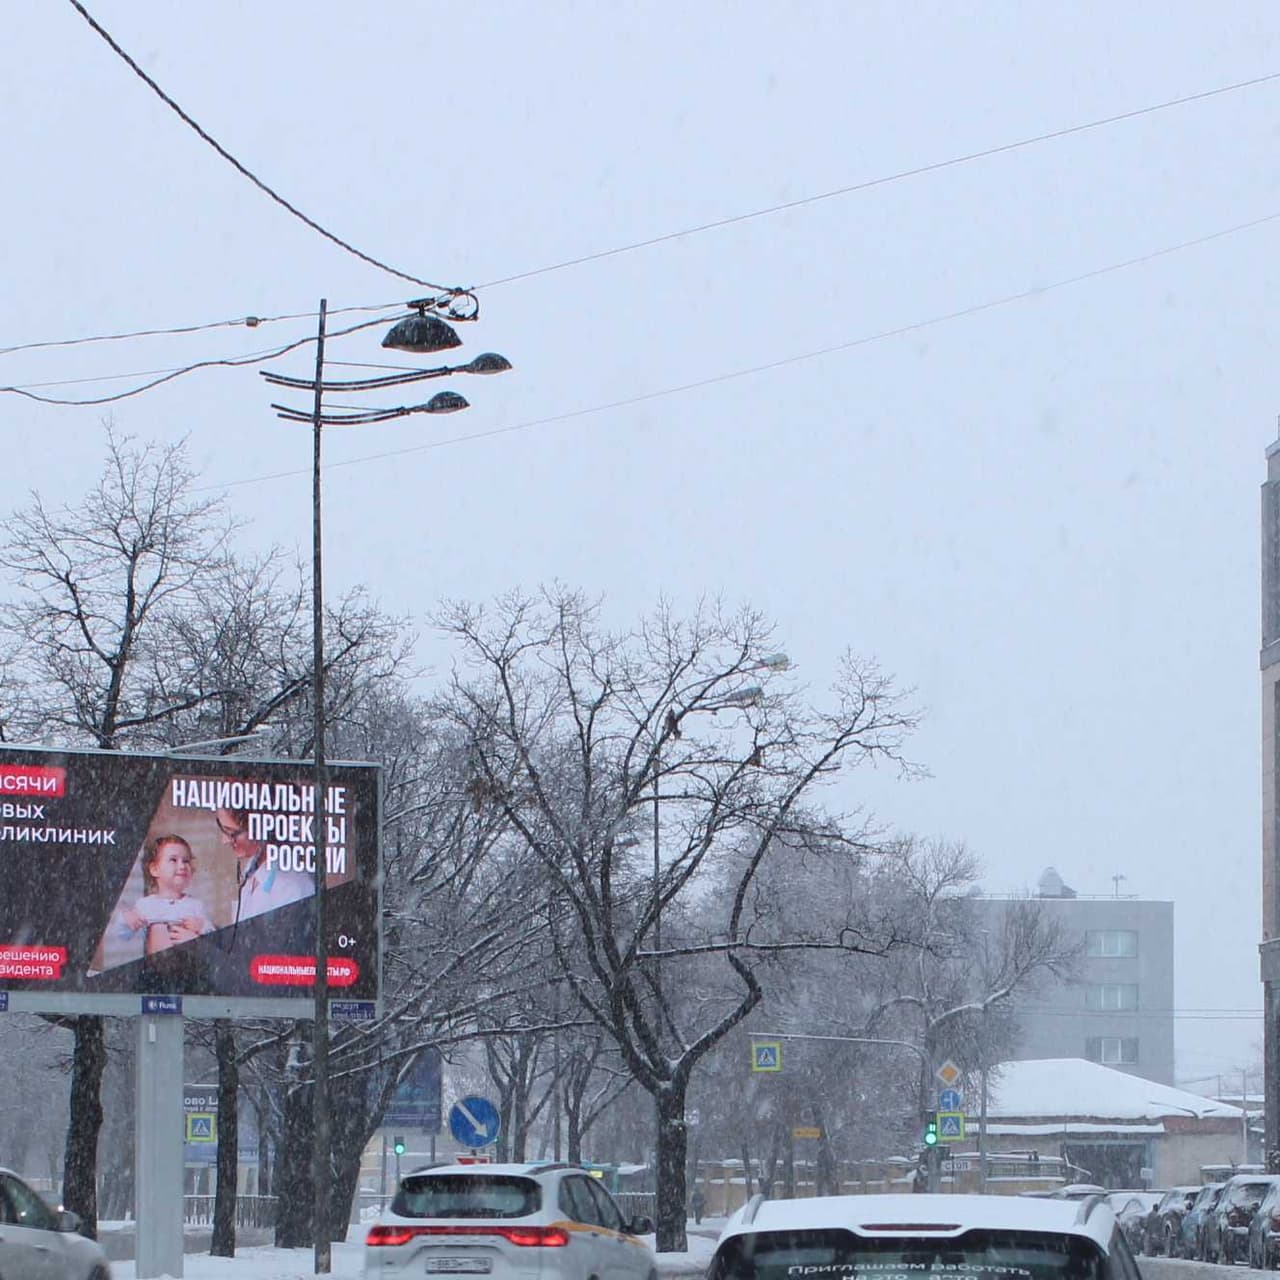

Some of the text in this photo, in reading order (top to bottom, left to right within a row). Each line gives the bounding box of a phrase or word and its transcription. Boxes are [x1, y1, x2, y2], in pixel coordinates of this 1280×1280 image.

[248, 813, 346, 845] ПРОЕКЫ
[337, 935, 357, 948] 0+
[787, 1262, 1031, 1276] Приглашаем работать
